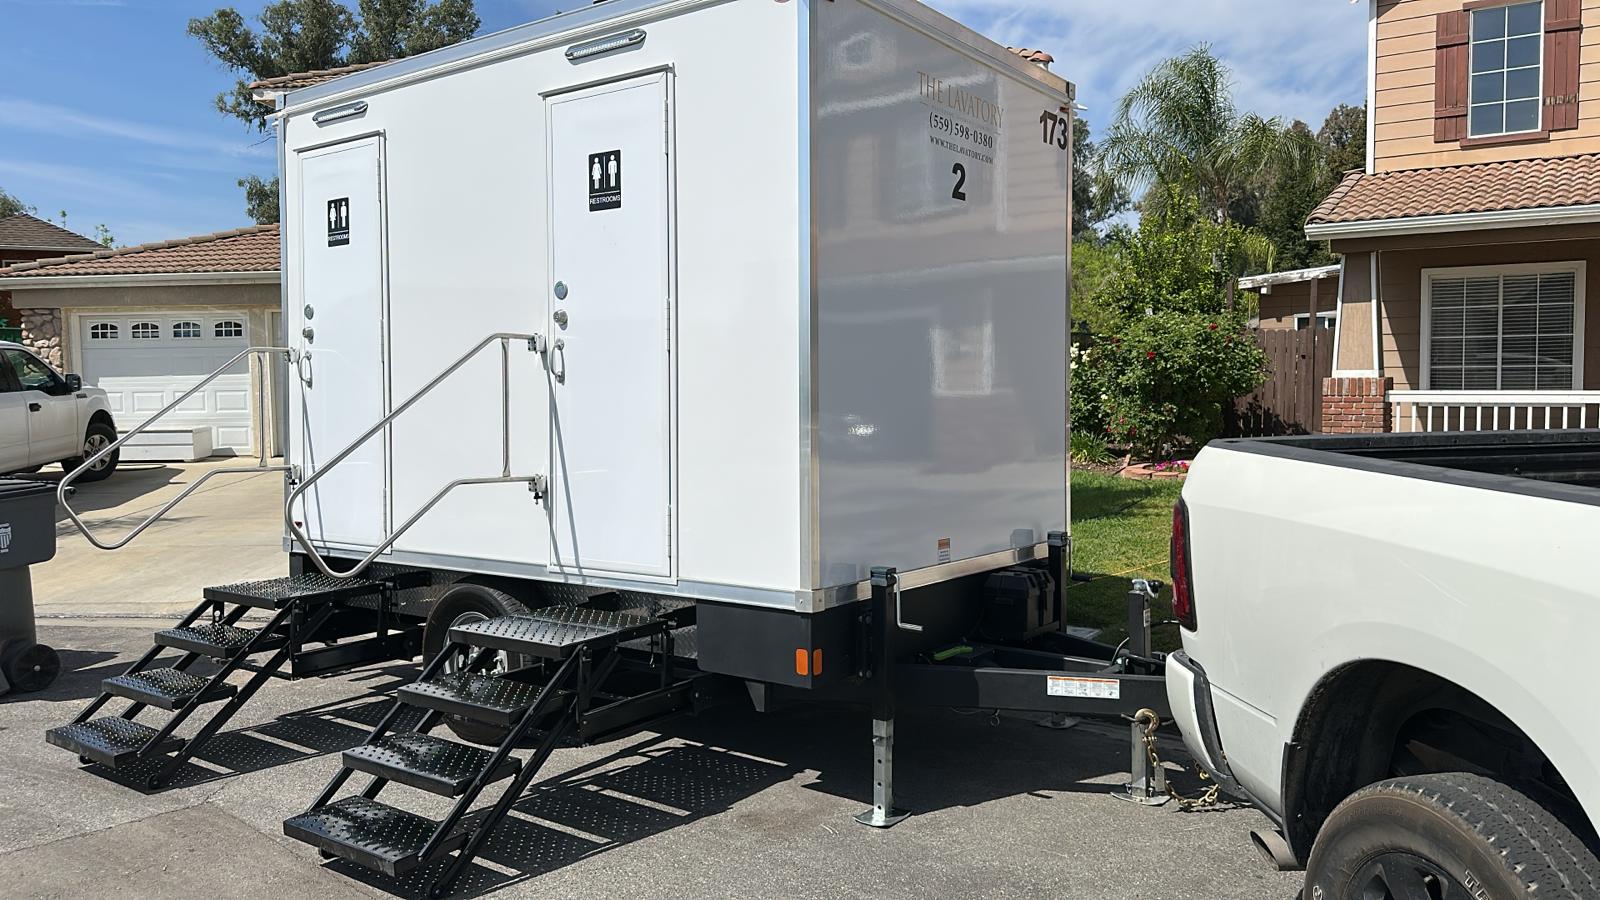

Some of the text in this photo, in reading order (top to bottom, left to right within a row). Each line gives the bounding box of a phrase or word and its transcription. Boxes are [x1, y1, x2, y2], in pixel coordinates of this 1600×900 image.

[917, 71, 944, 103] THE
[948, 84, 1004, 129] LAVATORY
[1039, 110, 1068, 150] 173
[589, 195, 621, 205] RESTROOMS
[951, 162, 966, 201] 2
